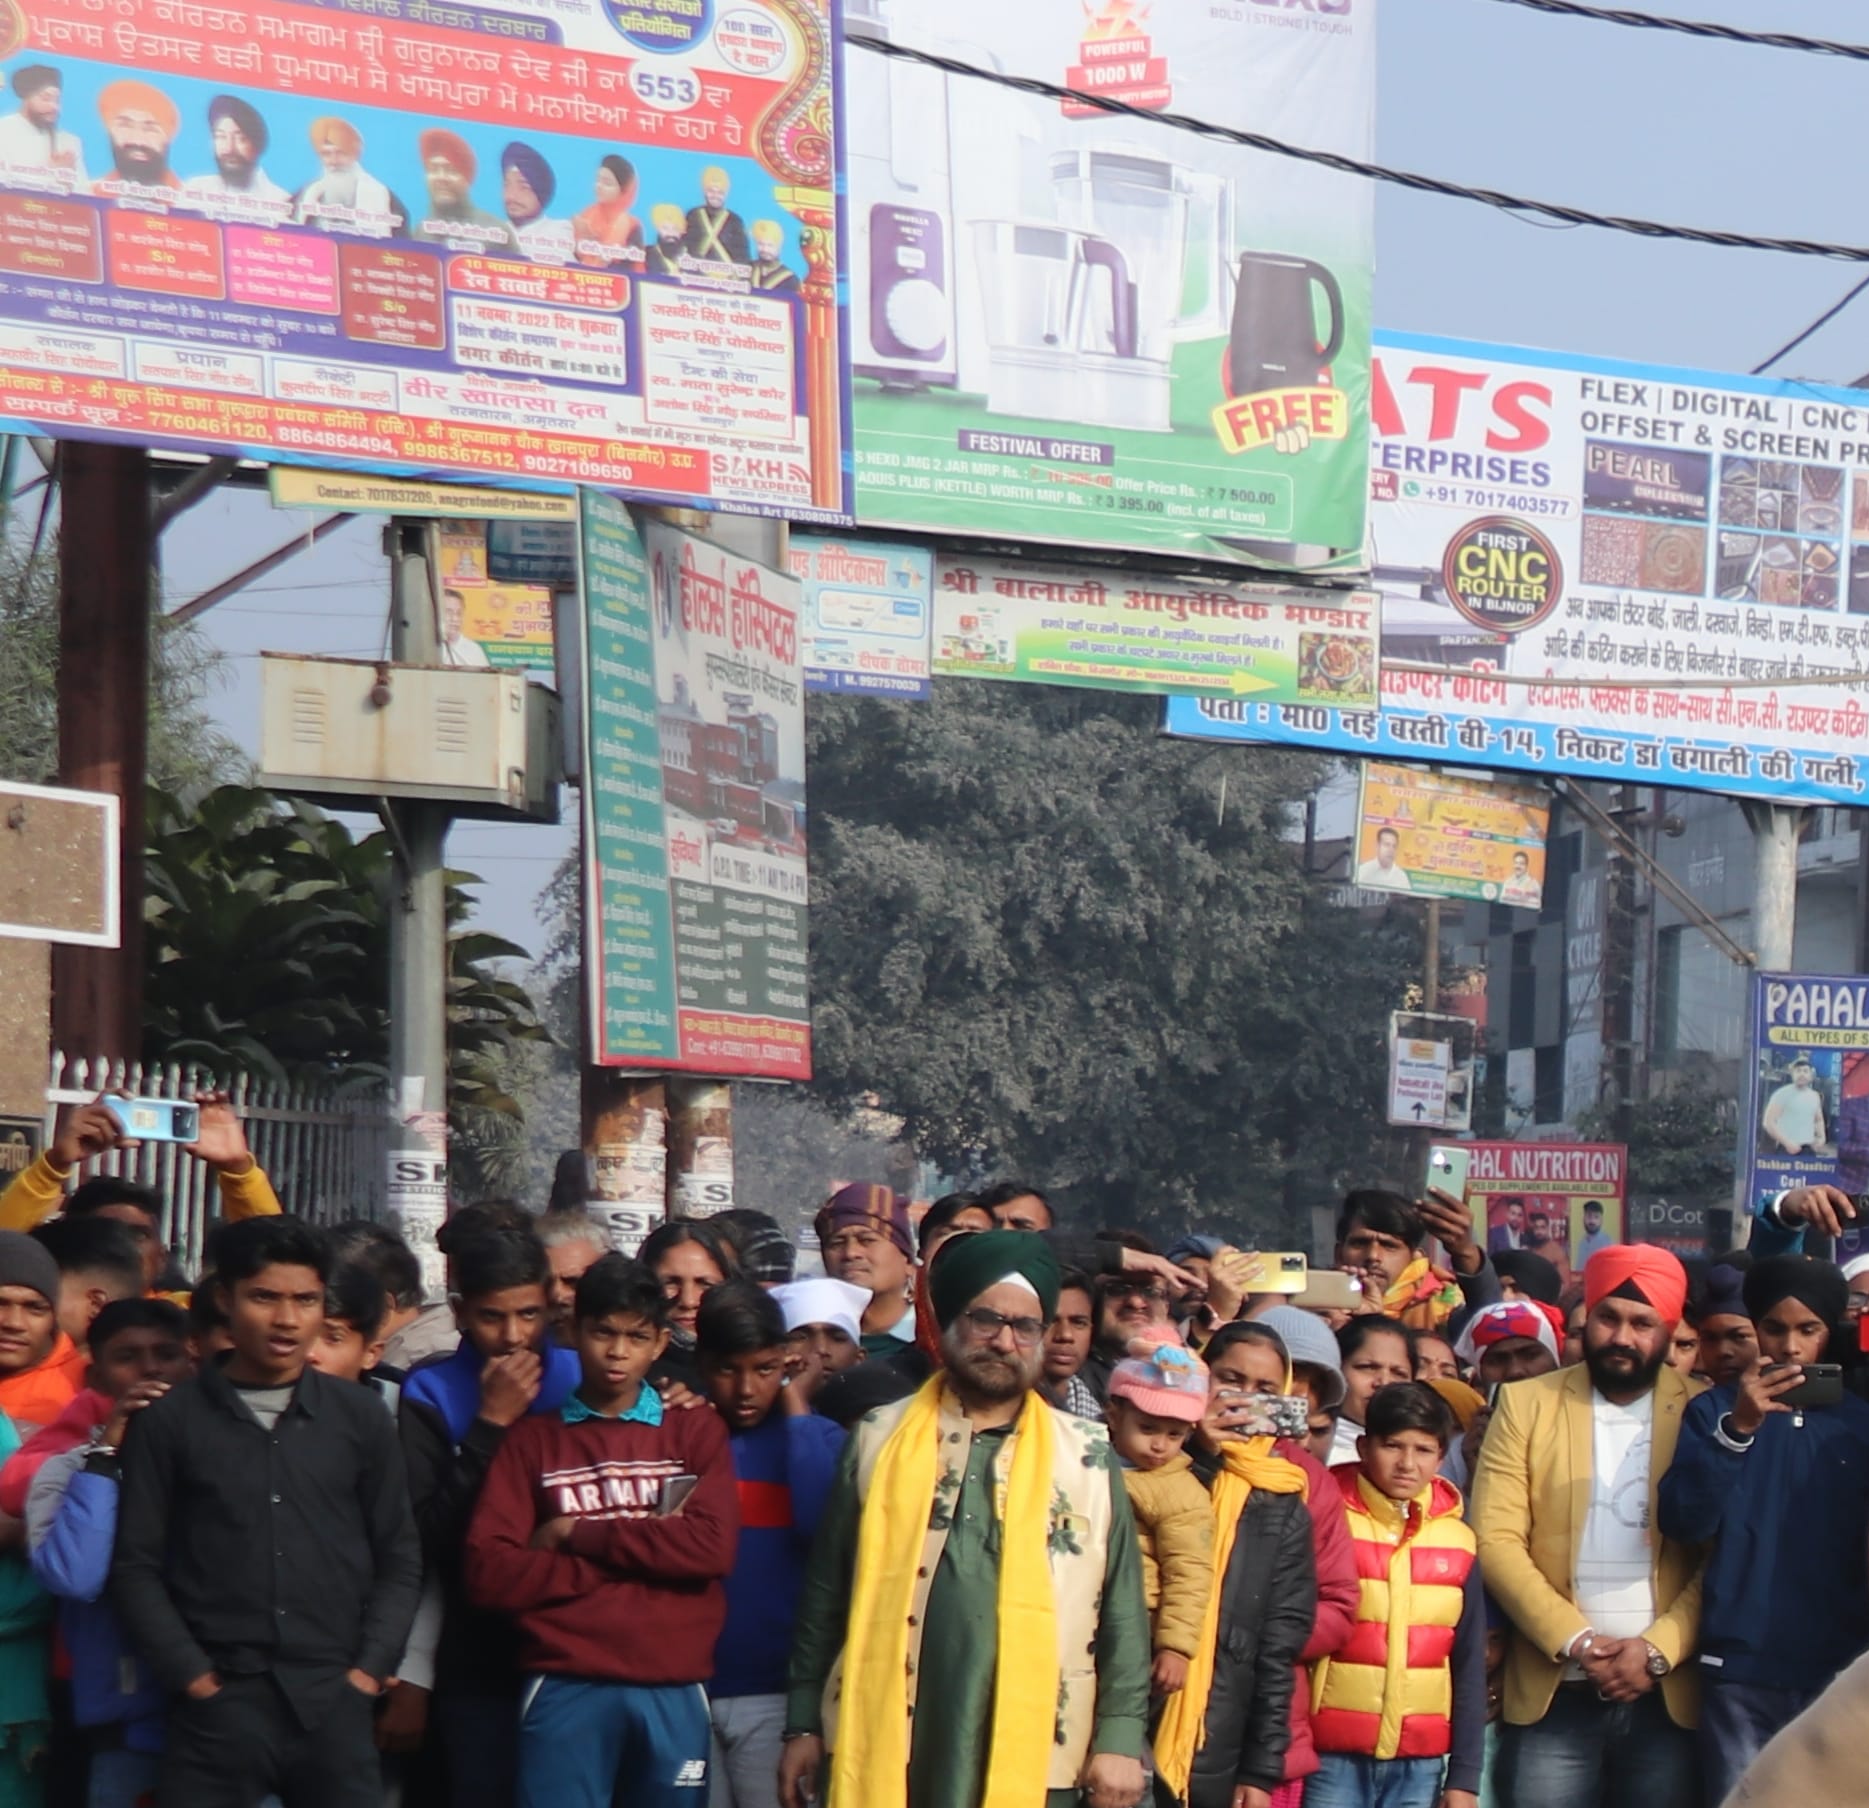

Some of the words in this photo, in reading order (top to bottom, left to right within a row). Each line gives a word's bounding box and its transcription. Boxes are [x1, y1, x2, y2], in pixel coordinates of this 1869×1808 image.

[1210, 7, 1243, 22] BOLD
[1254, 13, 1302, 29] STRONG
[1313, 19, 1352, 36] TOUGH
[1085, 40, 1147, 58] POWERFUL
[510, 50, 552, 82] ਦੇਵ
[560, 59, 589, 88] ਜੀ
[600, 67, 626, 91] ਕਾ
[637, 73, 696, 102] 553
[1085, 66, 1126, 87] 1000
[1129, 63, 1147, 80] W
[637, 109, 665, 134] ਜਾ
[675, 114, 716, 140] ਰਹਾ
[725, 117, 744, 147] ਹੈ
[531, 267, 568, 280] 2022
[458, 304, 471, 317] 11
[517, 312, 551, 328] 2022
[176, 350, 226, 369] प्रधान
[458, 344, 492, 362] नगर
[499, 347, 543, 368] कीर्तन
[713, 366, 728, 381] की
[732, 367, 758, 384] सेवा
[90, 381, 107, 401] श्री
[426, 421, 443, 442] श्री
[403, 379, 449, 402] वीर
[461, 384, 556, 415] खालसा
[566, 398, 609, 421] दल
[1580, 377, 1648, 407] FLEX
[1672, 389, 1779, 424] DIGITAL
[1802, 405, 1858, 433] CNC
[1224, 393, 1336, 447] FREE
[1580, 409, 1686, 443] OFFSET
[1694, 425, 1713, 446] &
[1722, 427, 1831, 461] SCREEN
[403, 440, 520, 471] 9986367512,
[524, 453, 633, 482] 9027109650
[969, 433, 1046, 458] FESTIVAL
[1051, 442, 1101, 463] OFFER
[903, 456, 930, 472] JMG
[933, 459, 941, 472] 2
[944, 460, 969, 475] JAR
[972, 462, 999, 478] MRP
[1116, 475, 1144, 493] Offer
[1146, 479, 1176, 495] Price
[1588, 445, 1681, 488] PEARL
[317, 484, 364, 501] Contact:
[713, 475, 749, 489] NEWS
[753, 479, 809, 497] EXPRESS
[899, 474, 930, 490] PLUS
[934, 477, 988, 497] (KETTLE)
[991, 482, 1033, 500] WORTH
[1036, 486, 1064, 503] MRP
[1119, 496, 1163, 513] 395.00
[1198, 504, 1210, 518] of
[1212, 507, 1227, 521] all
[1230, 508, 1266, 526] taxes)
[1426, 486, 1457, 503] +91
[1465, 490, 1569, 516] 7017403577
[720, 500, 760, 518] Khalsa
[763, 504, 781, 518] Art
[1477, 531, 1531, 550] FIRST
[1458, 545, 1549, 584] CNC
[941, 567, 981, 595] श्री
[993, 575, 1108, 606] बालाजी
[1123, 584, 1271, 623] आयुर्वेदिक
[1284, 603, 1372, 630] भण्डार
[1457, 576, 1548, 602] ROUTER
[1467, 597, 1483, 609] IN
[1486, 598, 1536, 615] BIJNOR
[1570, 637, 1585, 661] की
[1832, 699, 1869, 738] कटिंग
[1390, 712, 1447, 746] बस्ती
[1458, 718, 1543, 760] बी-14,
[1556, 729, 1624, 764] निकट
[1670, 739, 1750, 777] बंगाली
[1760, 749, 1793, 780] की
[1803, 753, 1864, 794] गली,
[1781, 1028, 1802, 1042] ALL
[1805, 1030, 1840, 1045] TYPES
[1843, 1031, 1857, 1046] OF
[1511, 1150, 1619, 1182] NUTRITION
